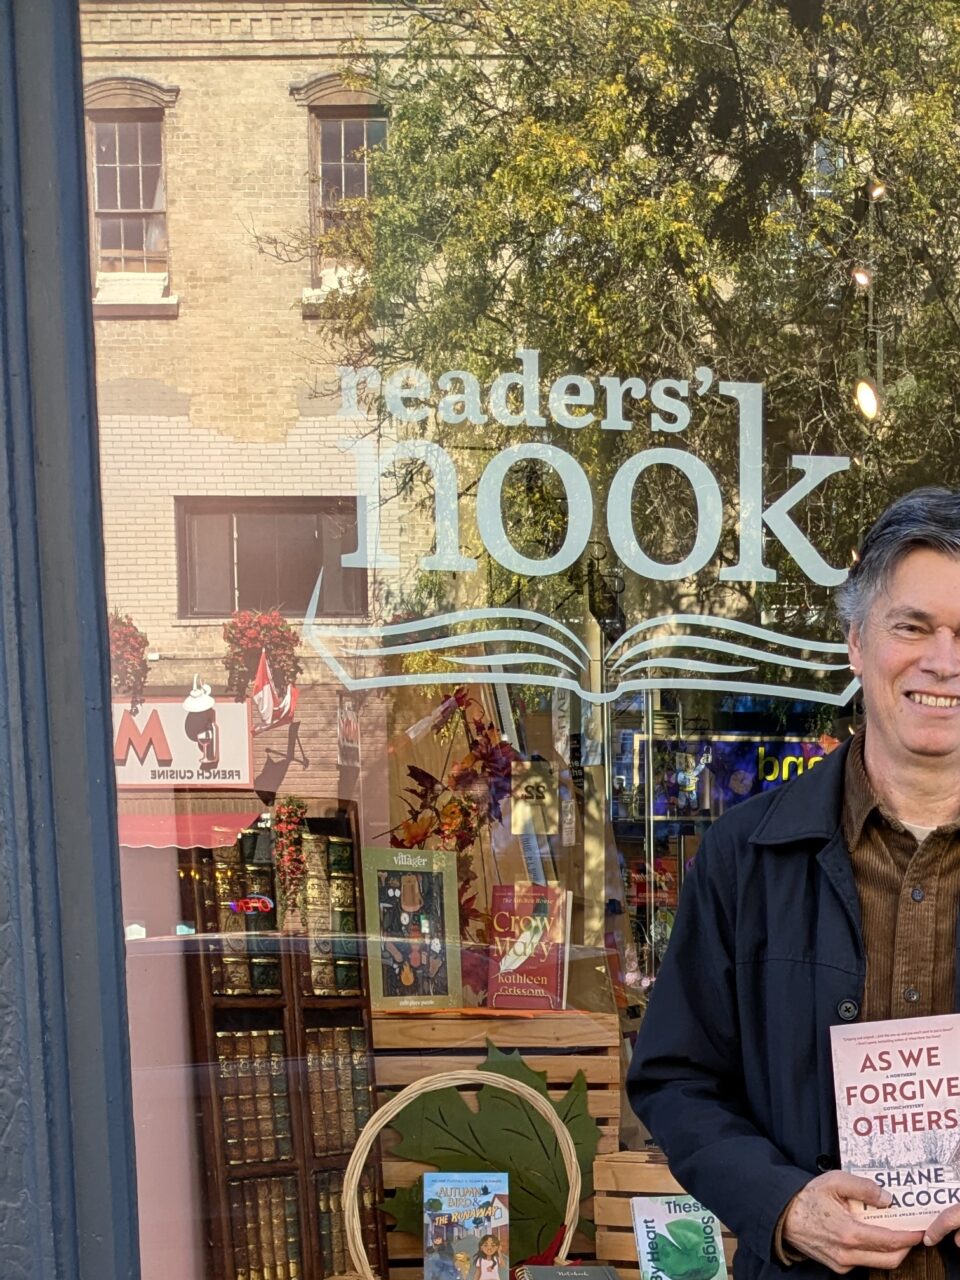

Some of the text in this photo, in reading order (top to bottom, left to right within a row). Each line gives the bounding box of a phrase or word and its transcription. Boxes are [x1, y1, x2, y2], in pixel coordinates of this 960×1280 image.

[337, 380, 850, 588] nook
[493, 911, 555, 934] Crow
[494, 936, 554, 963] Mary
[498, 972, 548, 985] Kathleen
[860, 1046, 941, 1073] AS WE
[845, 1076, 960, 1106] FORGIVE
[852, 1108, 958, 1137] OTHERS
[874, 1167, 945, 1188] SHANE
[438, 1186, 482, 1198] AUTUMN
[448, 1197, 480, 1208] BIRD &
[863, 1188, 960, 1211] ACOCK
[435, 1206, 498, 1226] THE RUNAWAY
[643, 1218, 661, 1263] Heart
[701, 1215, 718, 1264] Songs
